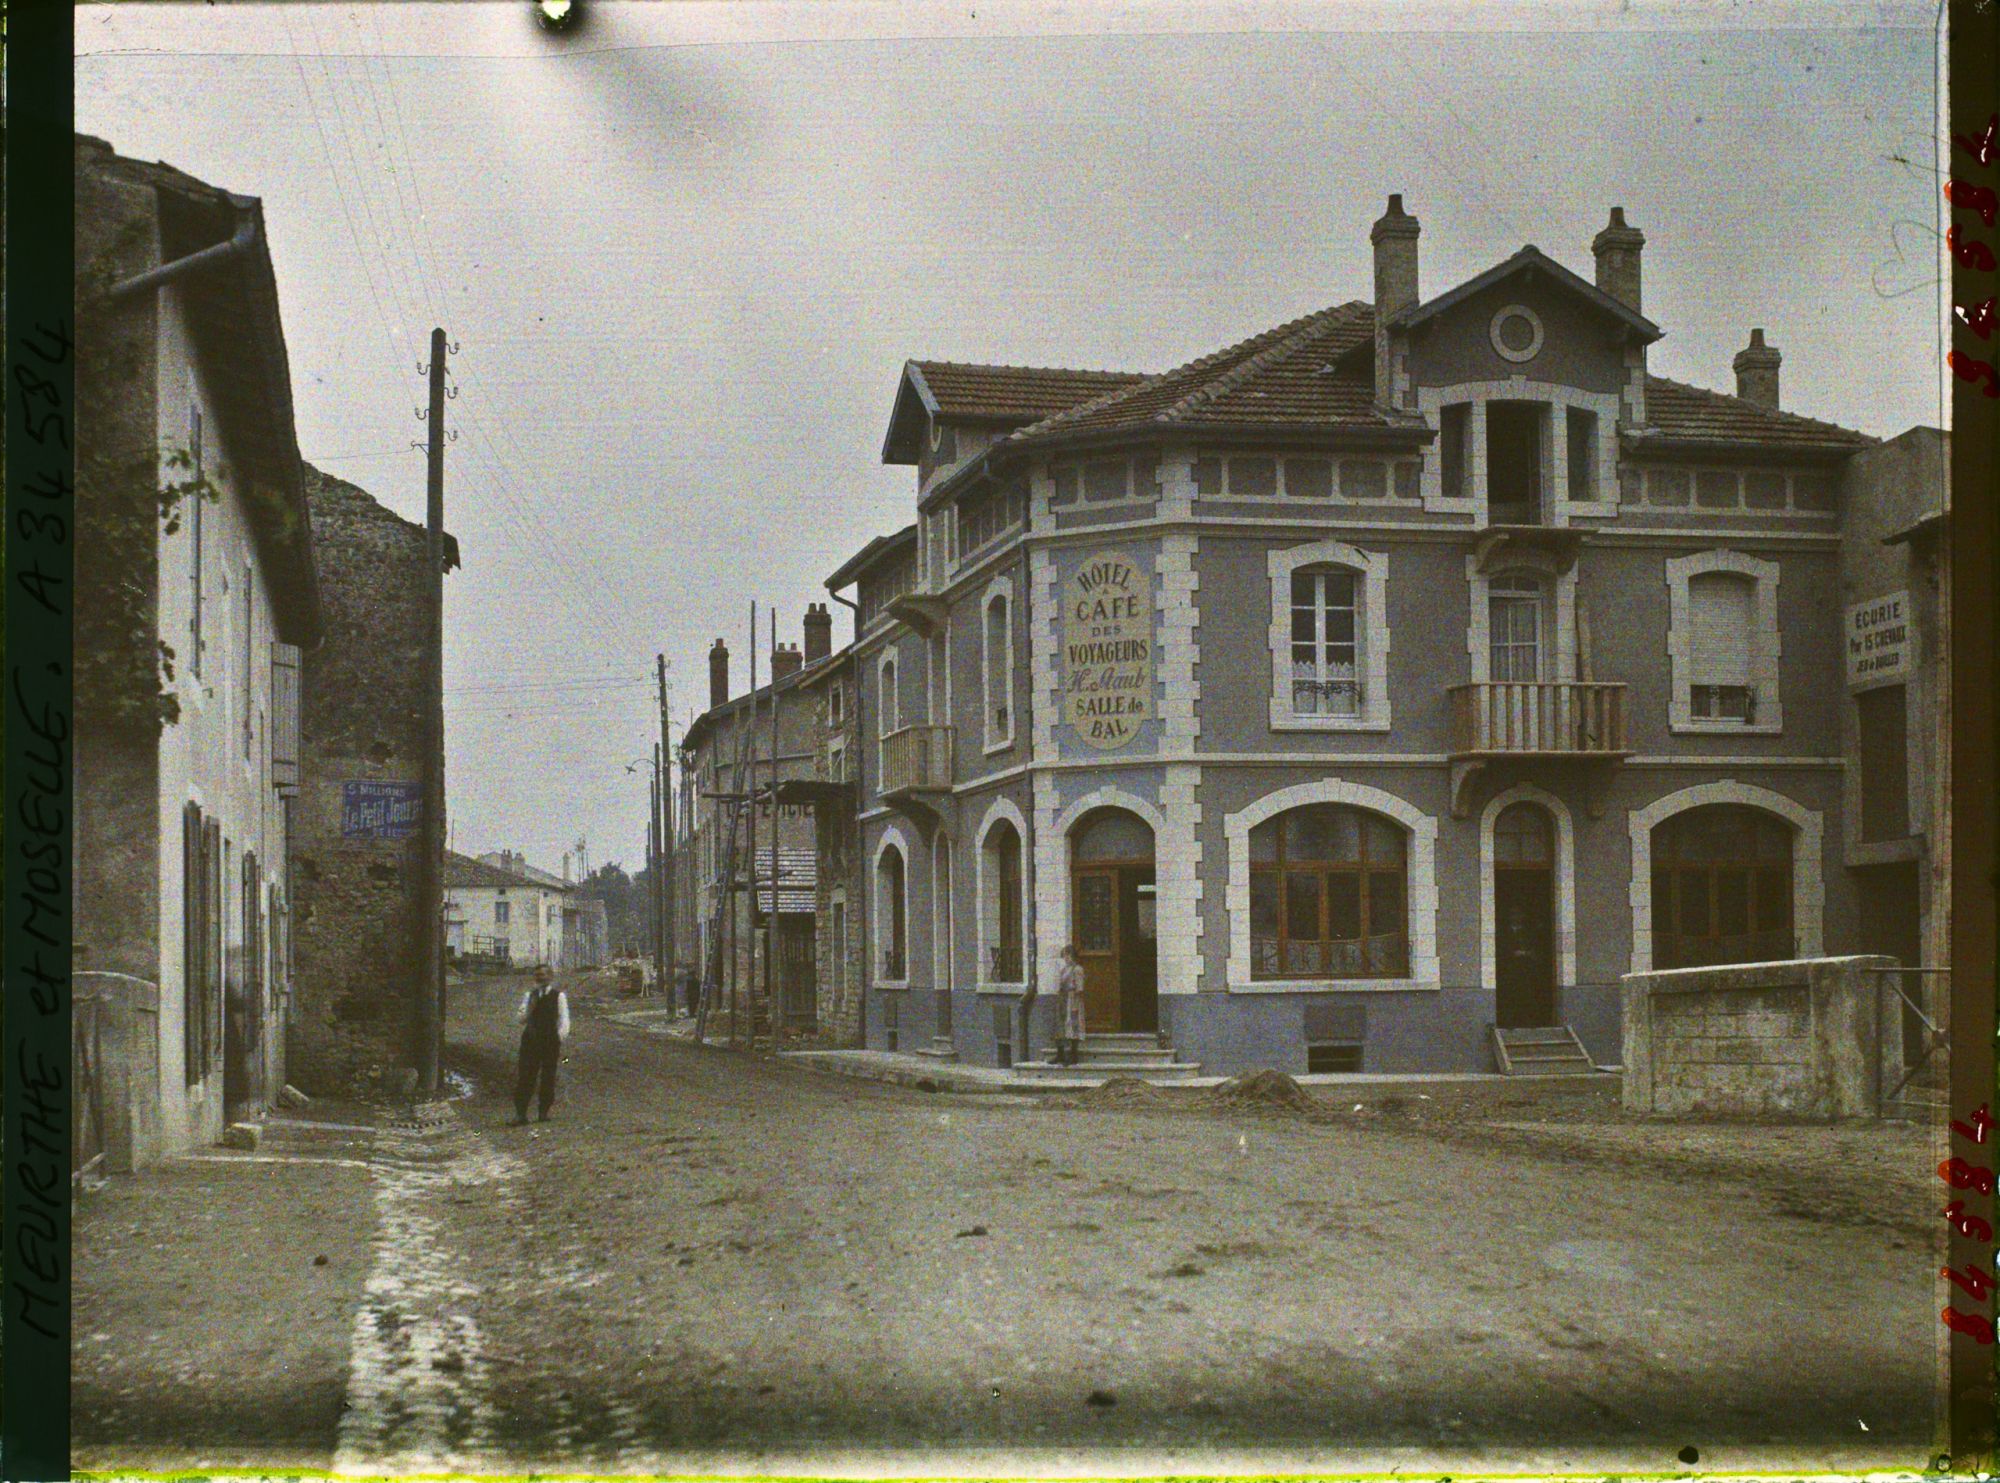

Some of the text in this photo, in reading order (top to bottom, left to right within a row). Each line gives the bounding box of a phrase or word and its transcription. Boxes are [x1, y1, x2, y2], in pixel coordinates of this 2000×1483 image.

[1092, 624, 1121, 637] DES
[1069, 638, 1148, 665] VOYAGEURS
[1076, 695, 1143, 717] SALLE de
[1091, 719, 1128, 739] BAL
[359, 799, 385, 829] Petit
